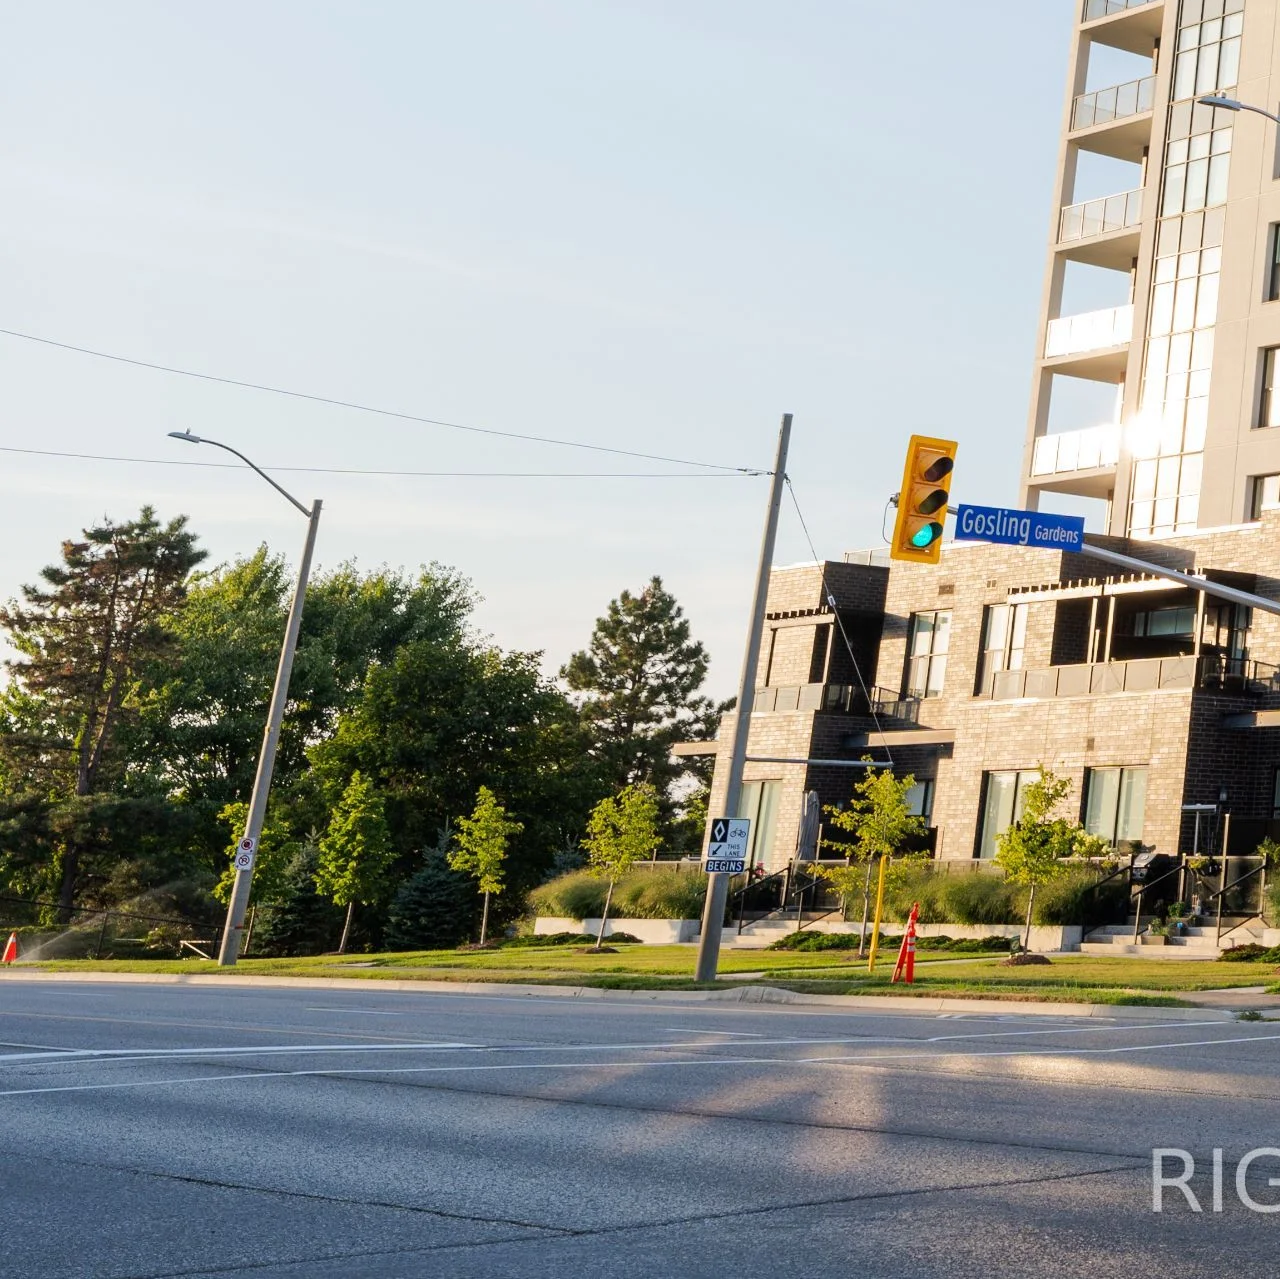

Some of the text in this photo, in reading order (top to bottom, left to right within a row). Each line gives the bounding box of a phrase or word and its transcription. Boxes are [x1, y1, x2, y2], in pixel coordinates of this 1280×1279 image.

[962, 508, 1079, 545] Gosling Gardens
[707, 861, 742, 871] BEGINS
